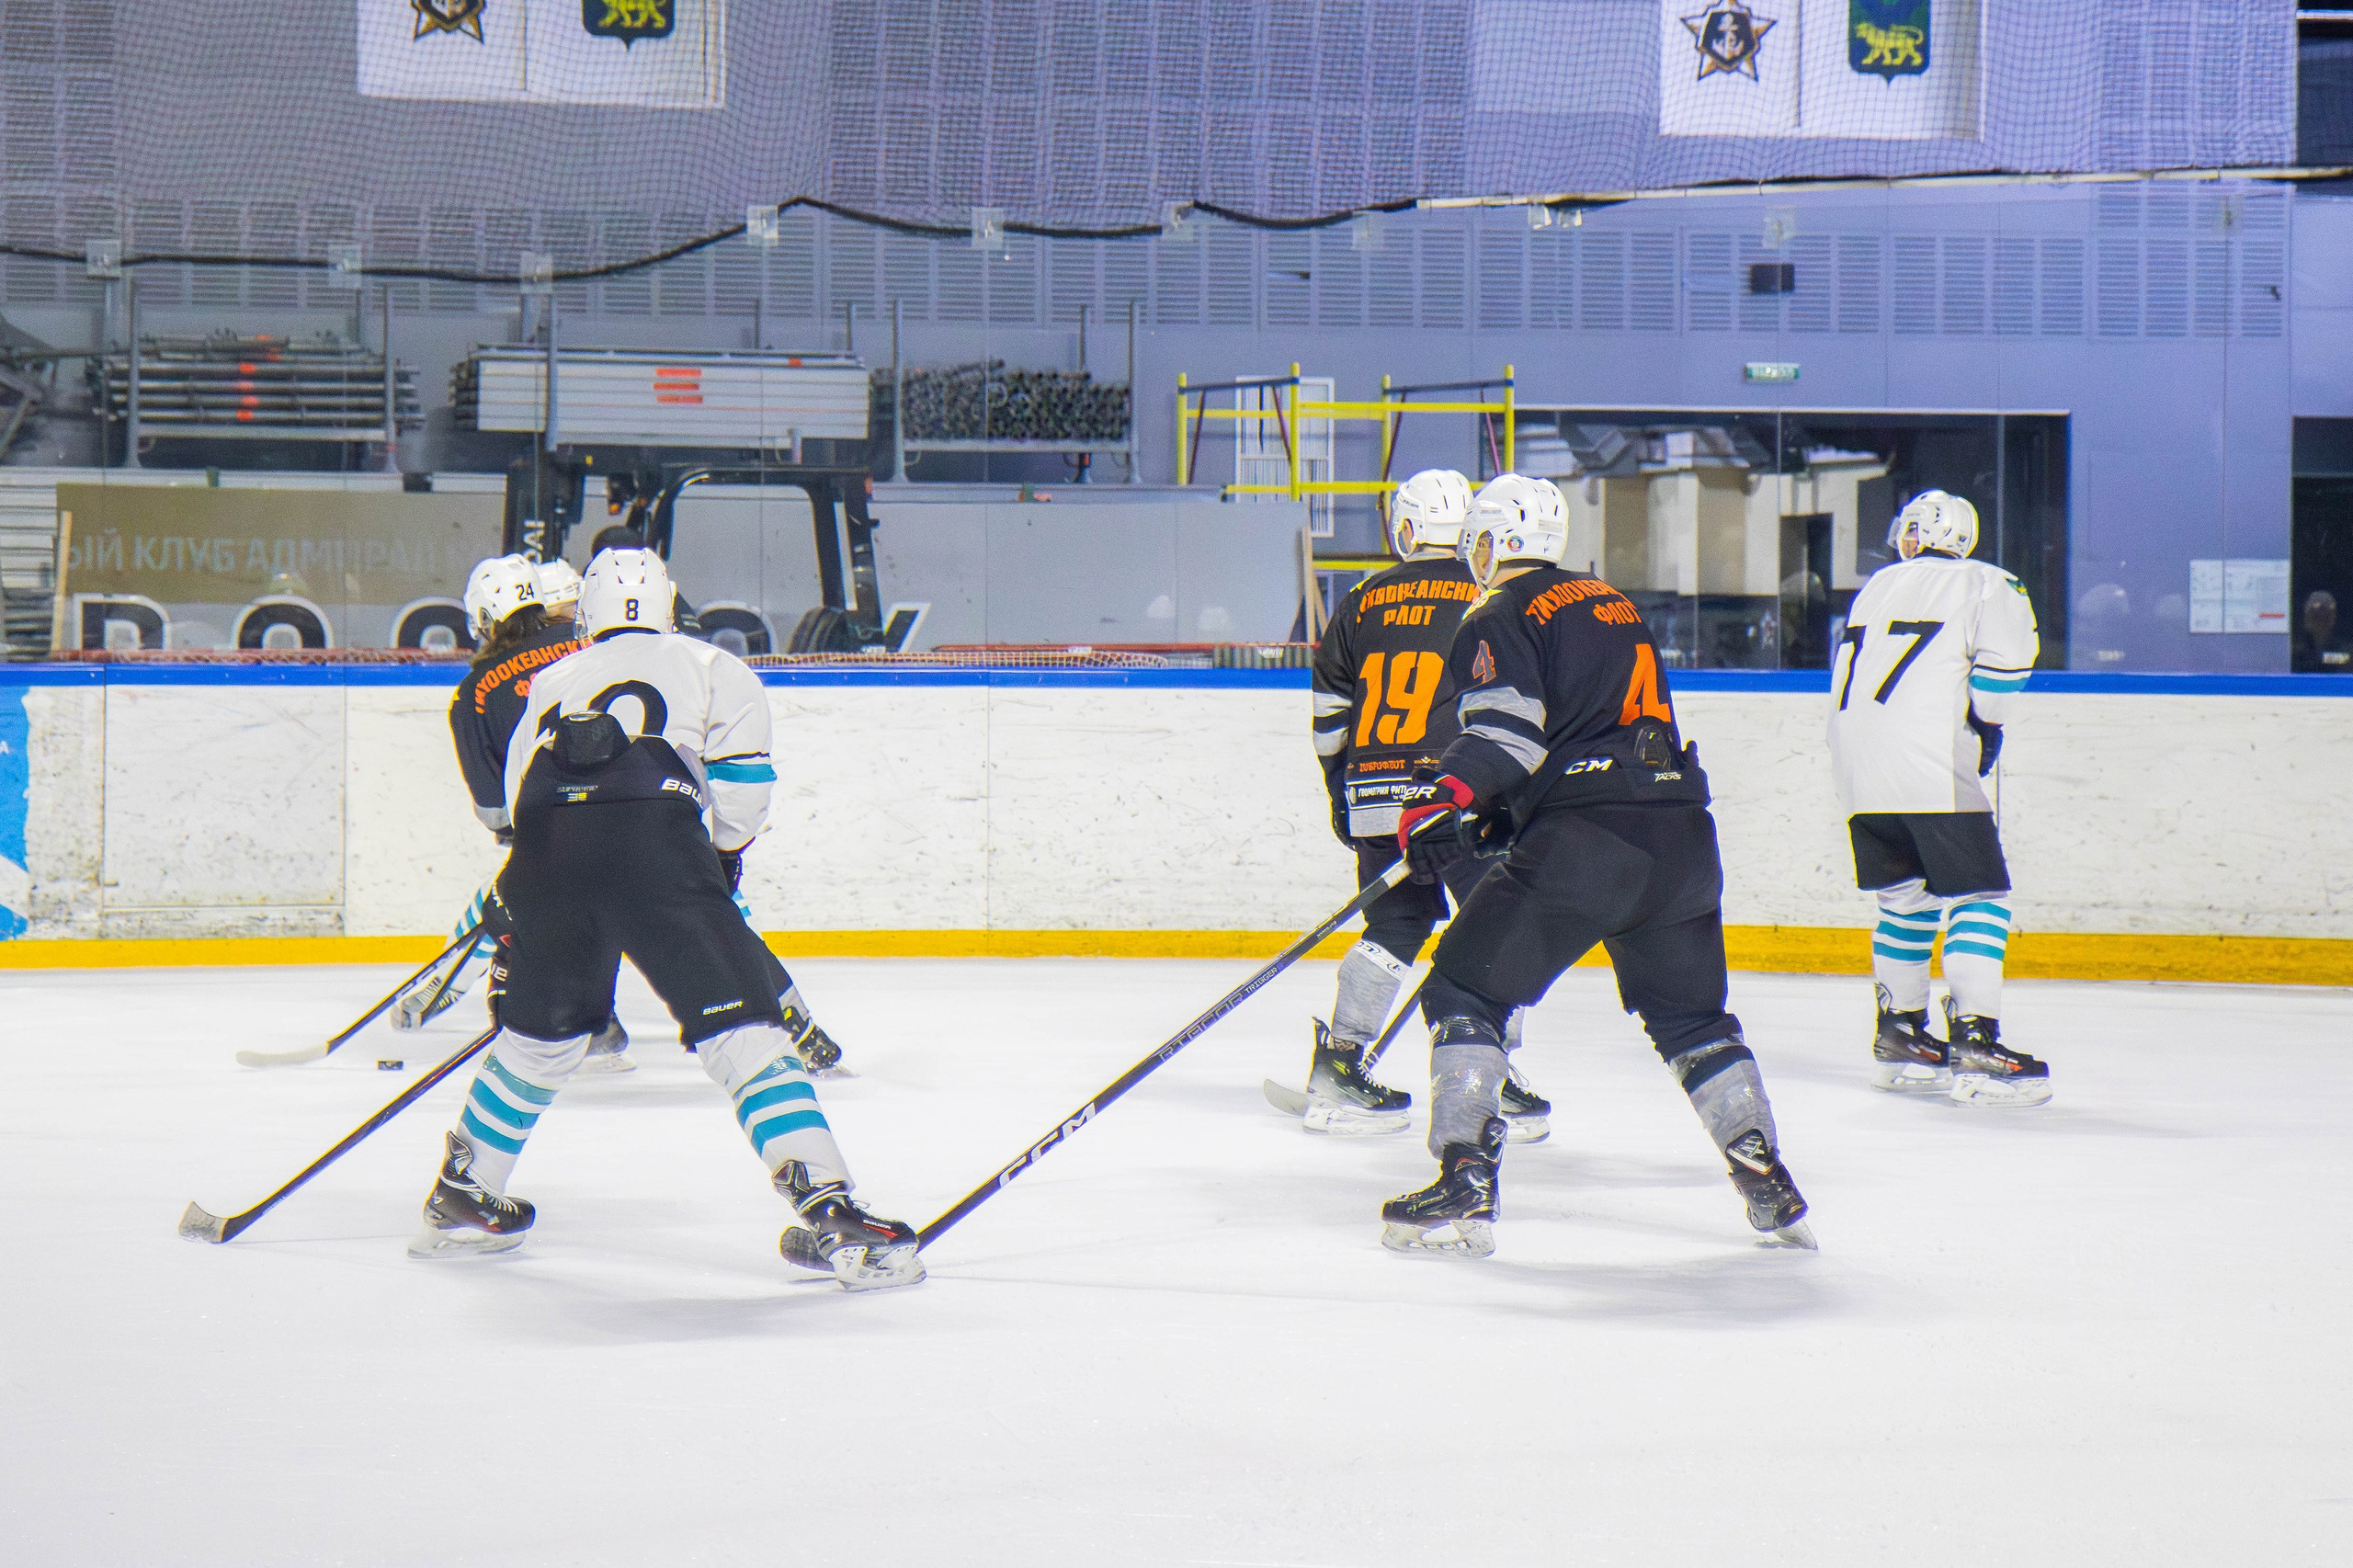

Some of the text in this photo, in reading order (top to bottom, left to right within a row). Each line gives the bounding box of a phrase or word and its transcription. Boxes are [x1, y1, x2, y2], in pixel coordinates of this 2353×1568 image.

[133, 537, 235, 572] КЛУБ
[515, 582, 535, 601] 24
[625, 597, 640, 622] 8
[1472, 640, 1496, 685] 4
[1356, 651, 1445, 748] 19
[1618, 643, 1672, 725] 4
[1244, 967, 1279, 994] TRIGGER
[999, 1102, 1096, 1188] CCM
